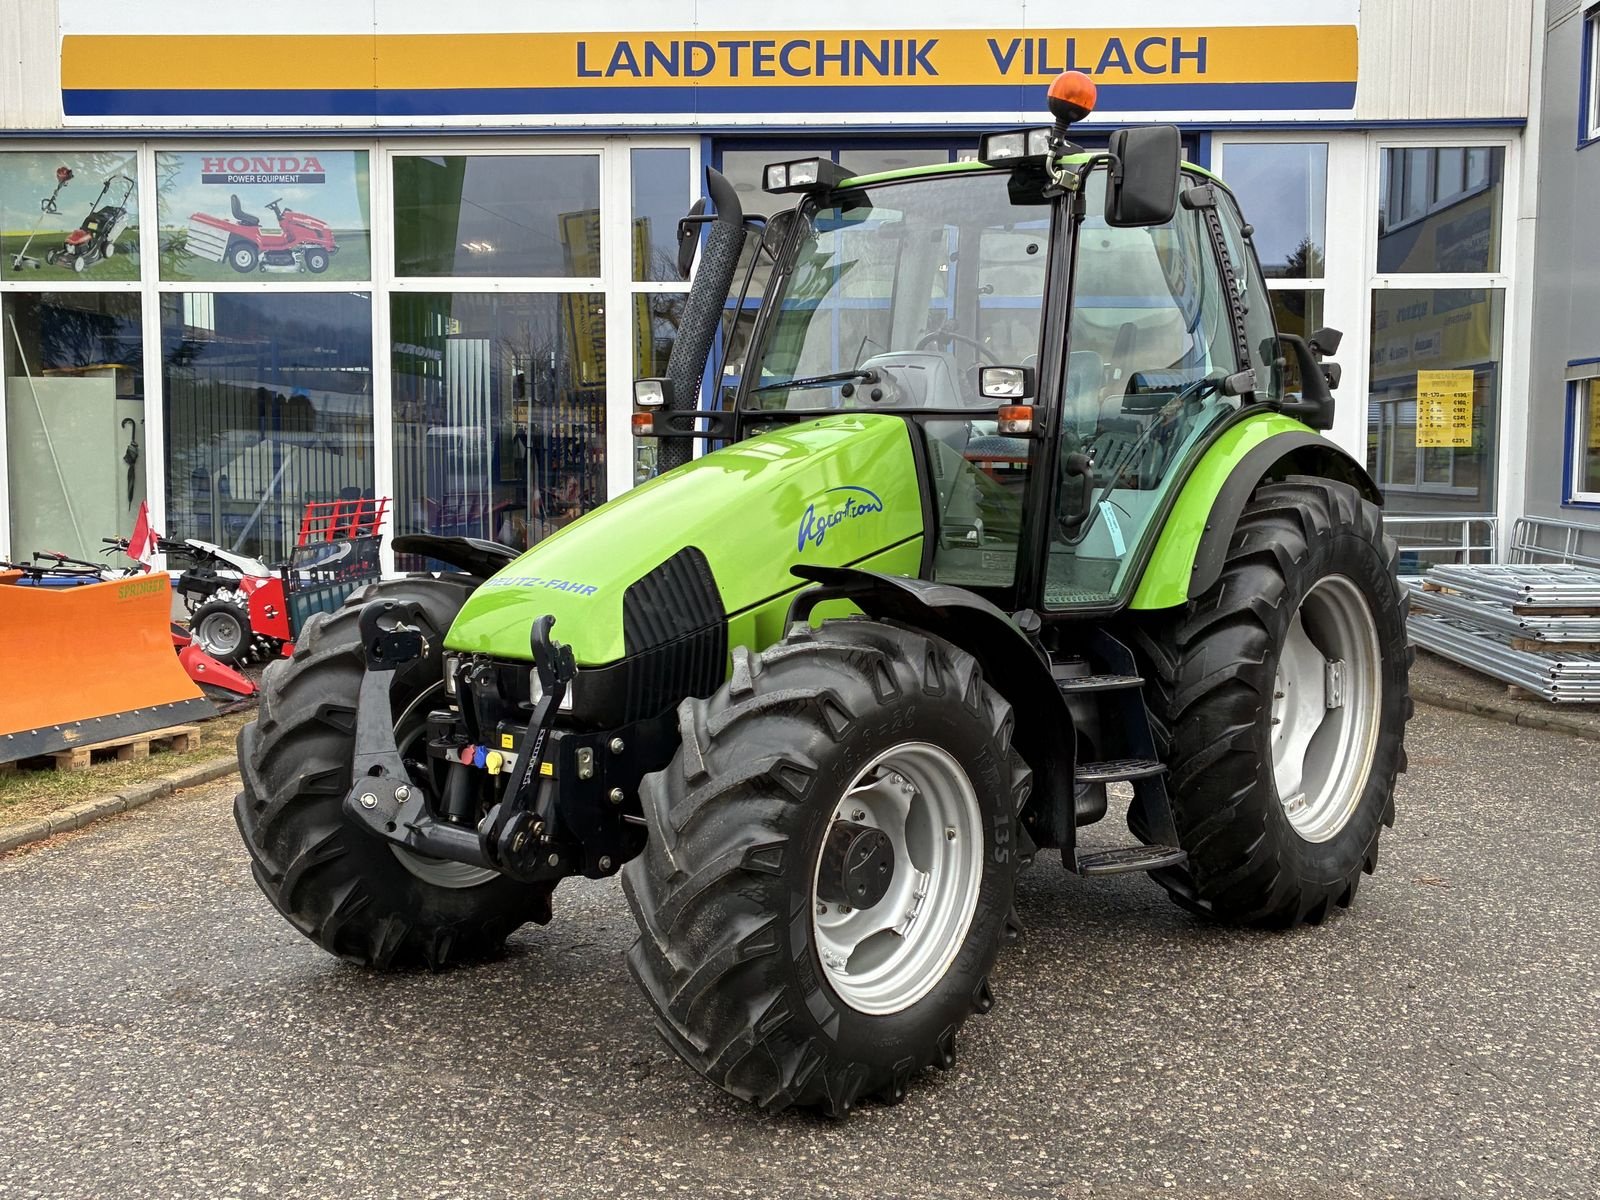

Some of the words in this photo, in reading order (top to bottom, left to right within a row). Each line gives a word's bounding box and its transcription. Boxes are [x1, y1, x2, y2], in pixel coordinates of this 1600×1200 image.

[577, 40, 939, 78] LANDTECHNIK
[987, 36, 1208, 75] VILLACH
[201, 157, 326, 173] HONDA
[227, 175, 255, 183] POWER
[256, 174, 300, 183] EQUIPMENT
[797, 486, 883, 553] Agrotron
[118, 577, 165, 600] SPRINGER
[484, 576, 598, 597] DEUTZ-FAHR
